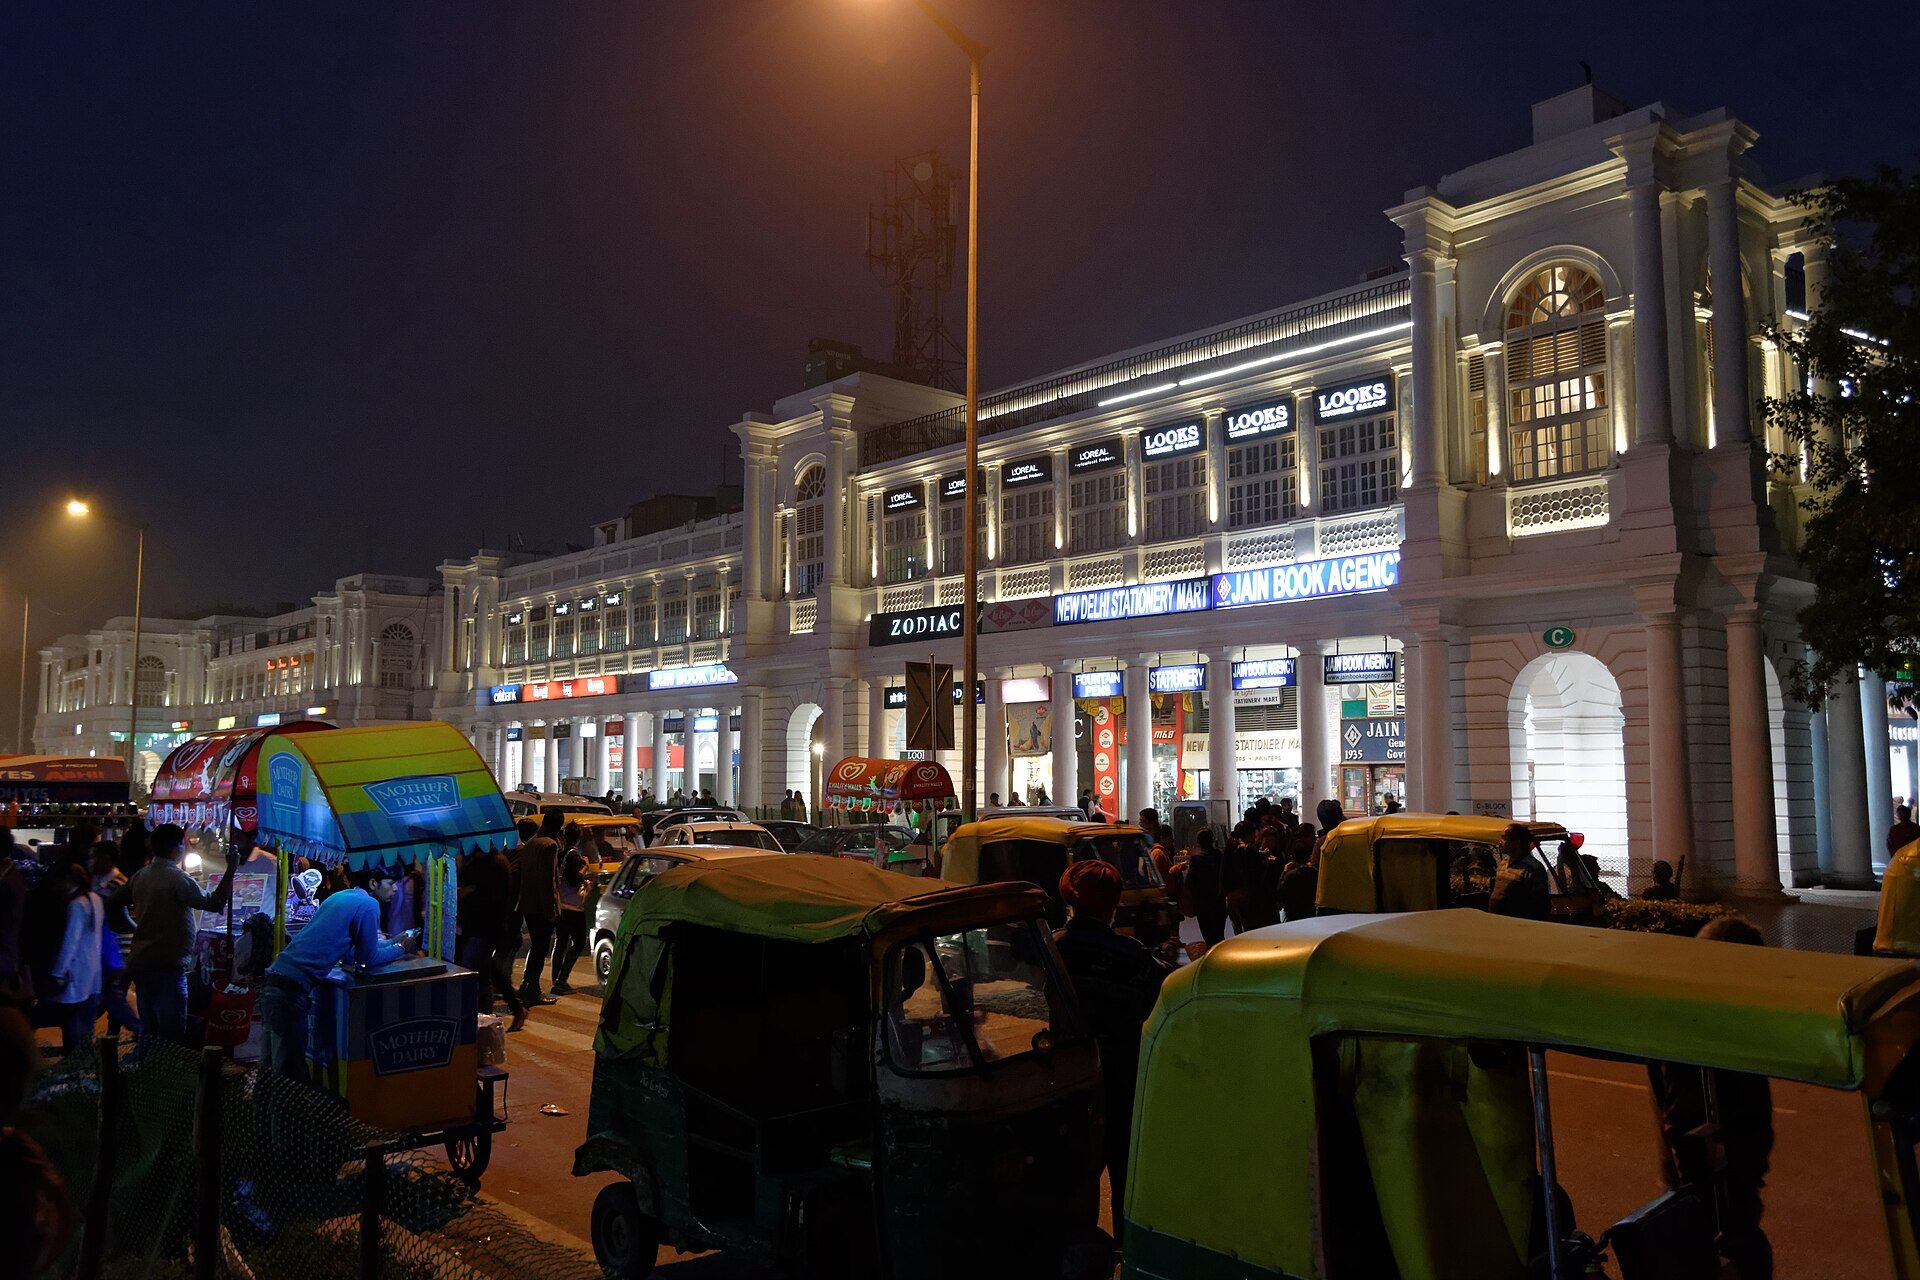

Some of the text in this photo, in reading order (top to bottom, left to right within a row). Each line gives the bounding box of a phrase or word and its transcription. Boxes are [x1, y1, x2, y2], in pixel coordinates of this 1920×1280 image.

[1318, 382, 1387, 411] LOOKS
[1227, 405, 1289, 431] LOOKS
[1144, 425, 1200, 450] LOOKS
[1231, 570, 1270, 604] JAIN
[1273, 562, 1326, 599] BOOK
[1057, 594, 1080, 622] NEW
[1080, 591, 1111, 620] DELHI
[1111, 584, 1176, 617] STATIONERY
[1176, 580, 1209, 611] MART
[891, 612, 961, 636] ZODIAC
[1551, 629, 1564, 645] C
[1326, 653, 1395, 672] JAIN BOOK AGENCY
[677, 669, 709, 686] BOOK
[1075, 672, 1121, 686] FOUNTAIN
[1149, 667, 1205, 690] STATIONERY
[1327, 672, 1393, 681] www.jainbookagency.com
[1367, 722, 1400, 738] JAIN
[1186, 741, 1205, 752] NEW
[1236, 738, 1301, 751] STATIONERY MA
[1344, 749, 1364, 760] 1935
[273, 765, 298, 788] MOTHER
[375, 780, 450, 801] MOTHER
[395, 793, 442, 808] DAIRY
[378, 1028, 450, 1054] MOTHER
[392, 1044, 439, 1065] DAIRY
